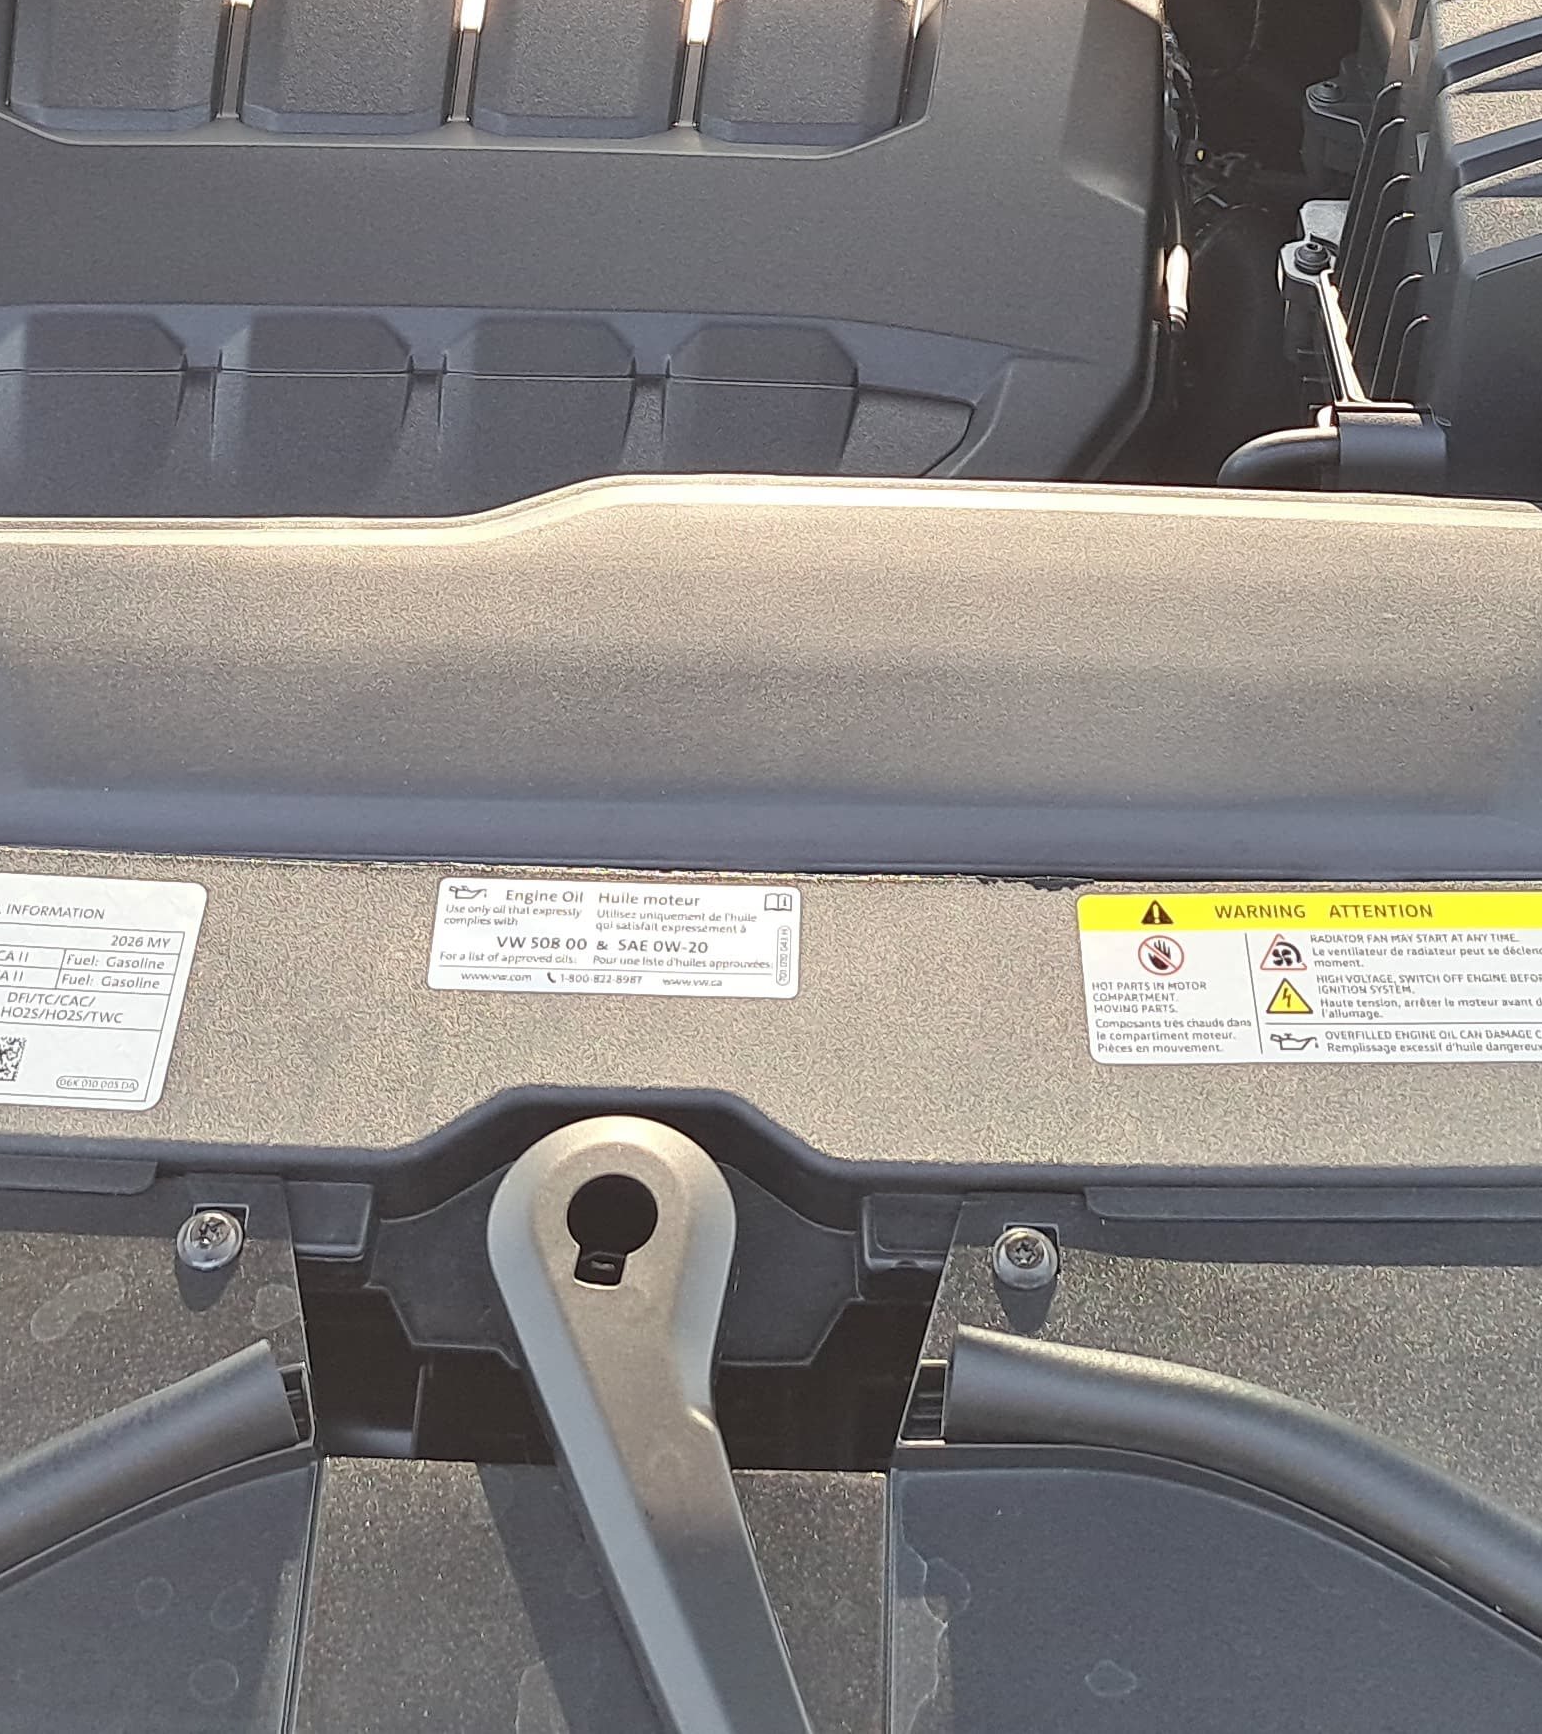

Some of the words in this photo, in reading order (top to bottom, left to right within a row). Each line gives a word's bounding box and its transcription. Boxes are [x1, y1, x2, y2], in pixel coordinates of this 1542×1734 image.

[505, 889, 558, 905] Engine
[561, 890, 584, 903] Oil
[598, 892, 639, 905] Huile
[643, 894, 700, 907] moteur
[6, 903, 105, 919] INFORMATION
[445, 903, 466, 914] Use
[467, 904, 491, 917] only
[492, 904, 506, 914] oil
[507, 904, 530, 915] that
[532, 907, 581, 919] expressly
[639, 912, 705, 922] uniquement
[707, 912, 722, 922] de
[724, 912, 757, 923] l'huile
[1214, 904, 1306, 919] WARNING
[1329, 903, 1433, 918] ATTENTION
[443, 915, 492, 927] complies
[493, 916, 518, 926] with
[594, 920, 613, 932] qui
[615, 921, 658, 932] satisfait
[110, 934, 144, 948] 2026
[146, 936, 171, 948] MY
[496, 935, 526, 949] VW
[530, 936, 561, 950] 508
[565, 937, 588, 951] 00
[595, 940, 608, 951] &
[618, 938, 648, 952] SAE
[652, 940, 708, 954] 0W-20
[1309, 933, 1364, 944] RADIATOR
[1366, 933, 1389, 944] FAN
[1390, 933, 1413, 943] MAY
[1415, 933, 1448, 943] START
[1450, 933, 1463, 943] AT
[1466, 933, 1488, 942] ANY
[439, 950, 458, 961] For
[458, 953, 466, 961] a
[468, 951, 485, 962] list
[486, 951, 500, 962] of
[500, 953, 553, 965] approved
[1311, 947, 1325, 957] Le
[1327, 946, 1387, 956] ventilateur
[1389, 946, 1404, 956] de
[1406, 946, 1456, 956] radiateur
[1459, 947, 1485, 958] peut
[1487, 947, 1500, 956] se
[66, 953, 99, 967] Fuel:
[105, 956, 165, 970] Gasoline
[592, 954, 617, 965] Pour
[641, 956, 664, 967] liste
[665, 957, 707, 968] d'huiles
[1313, 959, 1364, 968] moment.
[61, 973, 94, 986] Fuel:
[100, 975, 160, 989] Gasoline
[1315, 974, 1344, 984] HIGH
[1398, 973, 1441, 984] SWITCH
[1442, 973, 1463, 984] OFF
[1466, 973, 1507, 983] ENGINE
[1091, 980, 1113, 991] HOT
[1116, 981, 1151, 991] PARTS
[1152, 981, 1165, 991] IN
[1167, 980, 1207, 991] MOTOR
[1317, 984, 1367, 995] IGNITION
[1369, 983, 1415, 995] SYSTEM.
[6, 991, 96, 1008] DFI/TC/CAC/
[1092, 992, 1178, 1002] COMPARTMENT.
[1319, 997, 1354, 1008] Haute
[1355, 998, 1401, 1009] tension,
[1403, 997, 1441, 1008] arrêter
[1443, 996, 1455, 1007] le
[1457, 998, 1498, 1007] moteur
[1501, 998, 1533, 1007] avant
[1093, 1003, 1139, 1014] MOVING
[1141, 1003, 1178, 1014] PARTS.
[1321, 1008, 1383, 1021] l'allumage.
[1094, 1018, 1162, 1029] Composants
[1163, 1019, 1185, 1028] très
[1186, 1017, 1225, 1028] chauds
[1226, 1017, 1252, 1028] dans
[1095, 1030, 1107, 1041] le
[1109, 1031, 1189, 1045] compartiment
[1191, 1031, 1236, 1040] moteur.
[1324, 1030, 1392, 1040] OVERFILLED
[1394, 1029, 1437, 1040] ENGINE
[1438, 1029, 1457, 1040] OIL
[1459, 1029, 1483, 1040] CAN
[1484, 1029, 1533, 1039] DAMAGE
[1097, 1042, 1133, 1053] Pièces
[1135, 1044, 1150, 1053] en
[1152, 1043, 1222, 1053] mouvement.
[1326, 1042, 1397, 1055] Remplissage
[1399, 1042, 1442, 1052] excessif
[1445, 1041, 1483, 1052] d'huile
